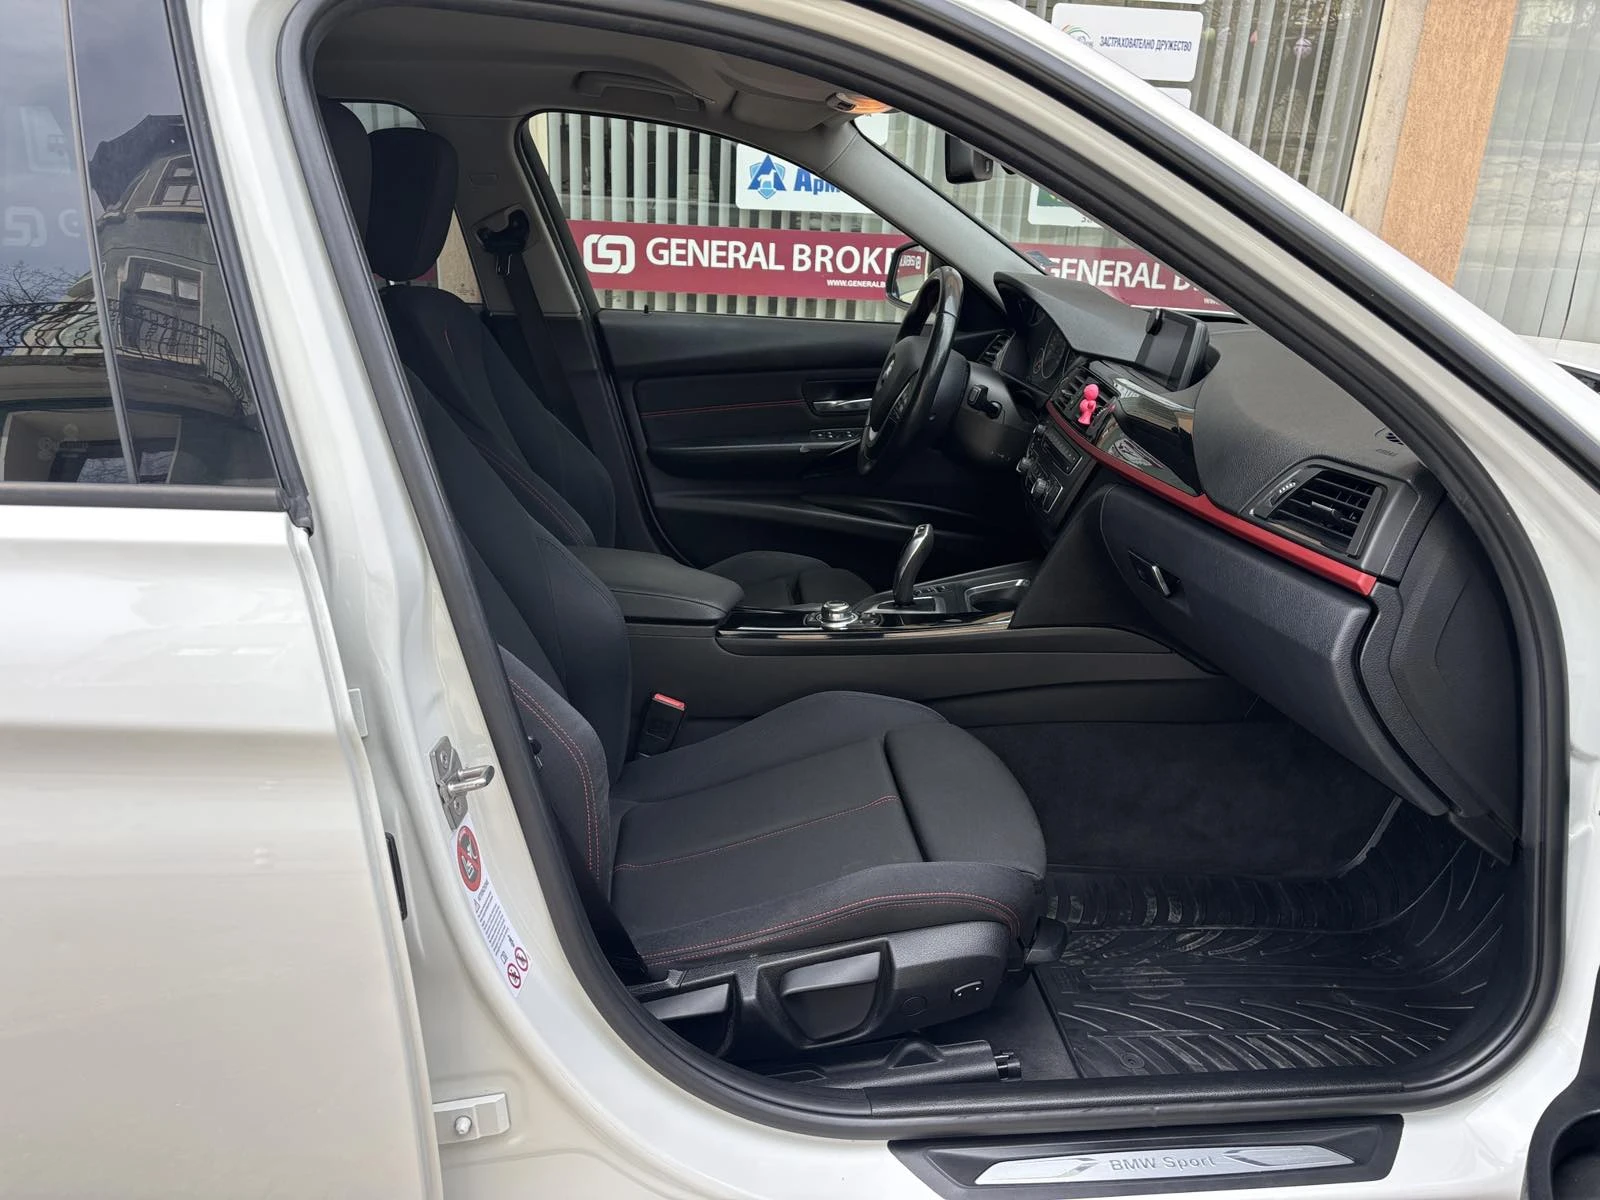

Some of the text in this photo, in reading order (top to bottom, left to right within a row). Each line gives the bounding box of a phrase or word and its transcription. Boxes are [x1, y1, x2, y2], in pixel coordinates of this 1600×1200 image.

[1155, 39, 1192, 52] ДРУЖЕСТВО
[645, 236, 785, 271] GENERAL
[1109, 1155, 1216, 1171] BMW Sport
